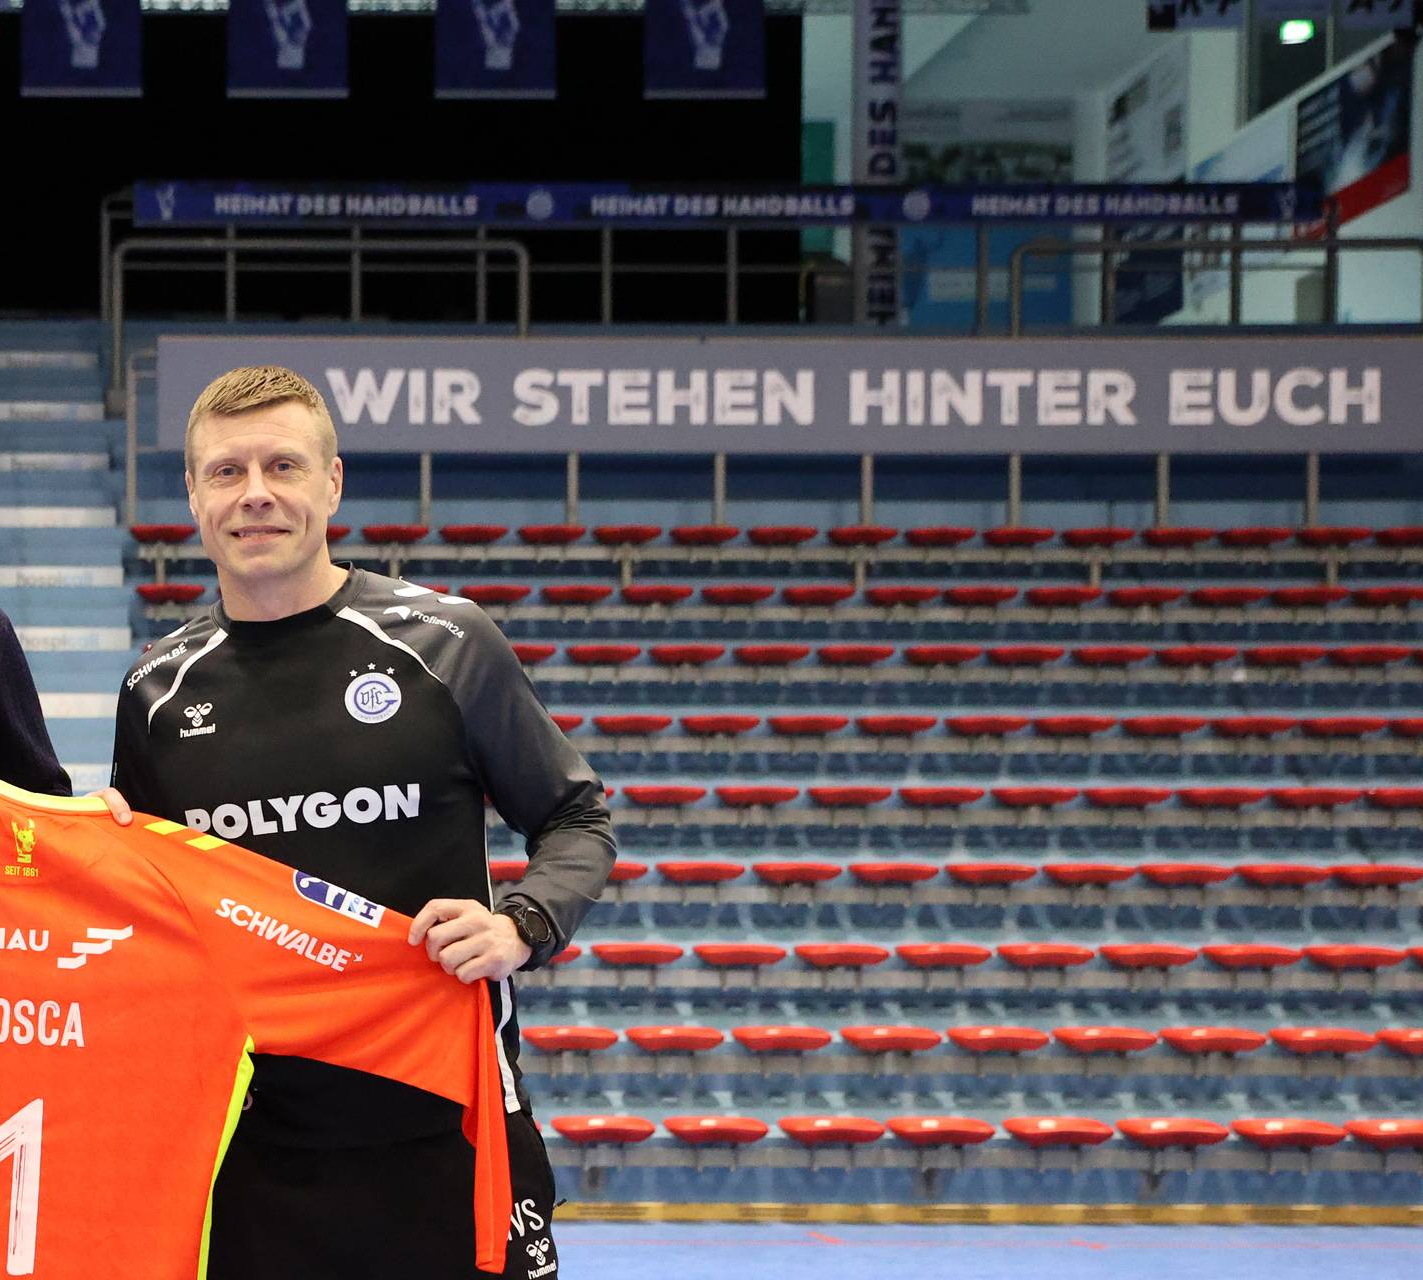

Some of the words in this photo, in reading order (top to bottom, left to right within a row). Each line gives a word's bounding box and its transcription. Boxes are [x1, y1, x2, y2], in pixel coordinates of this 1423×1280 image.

[868, 101, 898, 177] DES
[214, 194, 292, 216] HEIMAT
[296, 194, 340, 216] DES
[345, 194, 478, 216] HANDBALLS
[591, 194, 669, 216] HEIMAT
[674, 194, 718, 216] DES
[722, 194, 854, 216] HANDBALLS
[326, 367, 481, 426] WIR
[513, 367, 814, 426] STEHEN
[850, 367, 1137, 426] HINTER
[1169, 367, 1381, 426] EUCH
[126, 642, 188, 691] SCHWALBE
[179, 723, 216, 739] hummel
[185, 783, 421, 839] POLYGON
[4, 865, 21, 876] SEIT
[23, 867, 39, 877] 1861
[215, 898, 353, 972] SCHWALBE
[507, 1198, 545, 1241] VS
[527, 1259, 558, 1280] hummel
